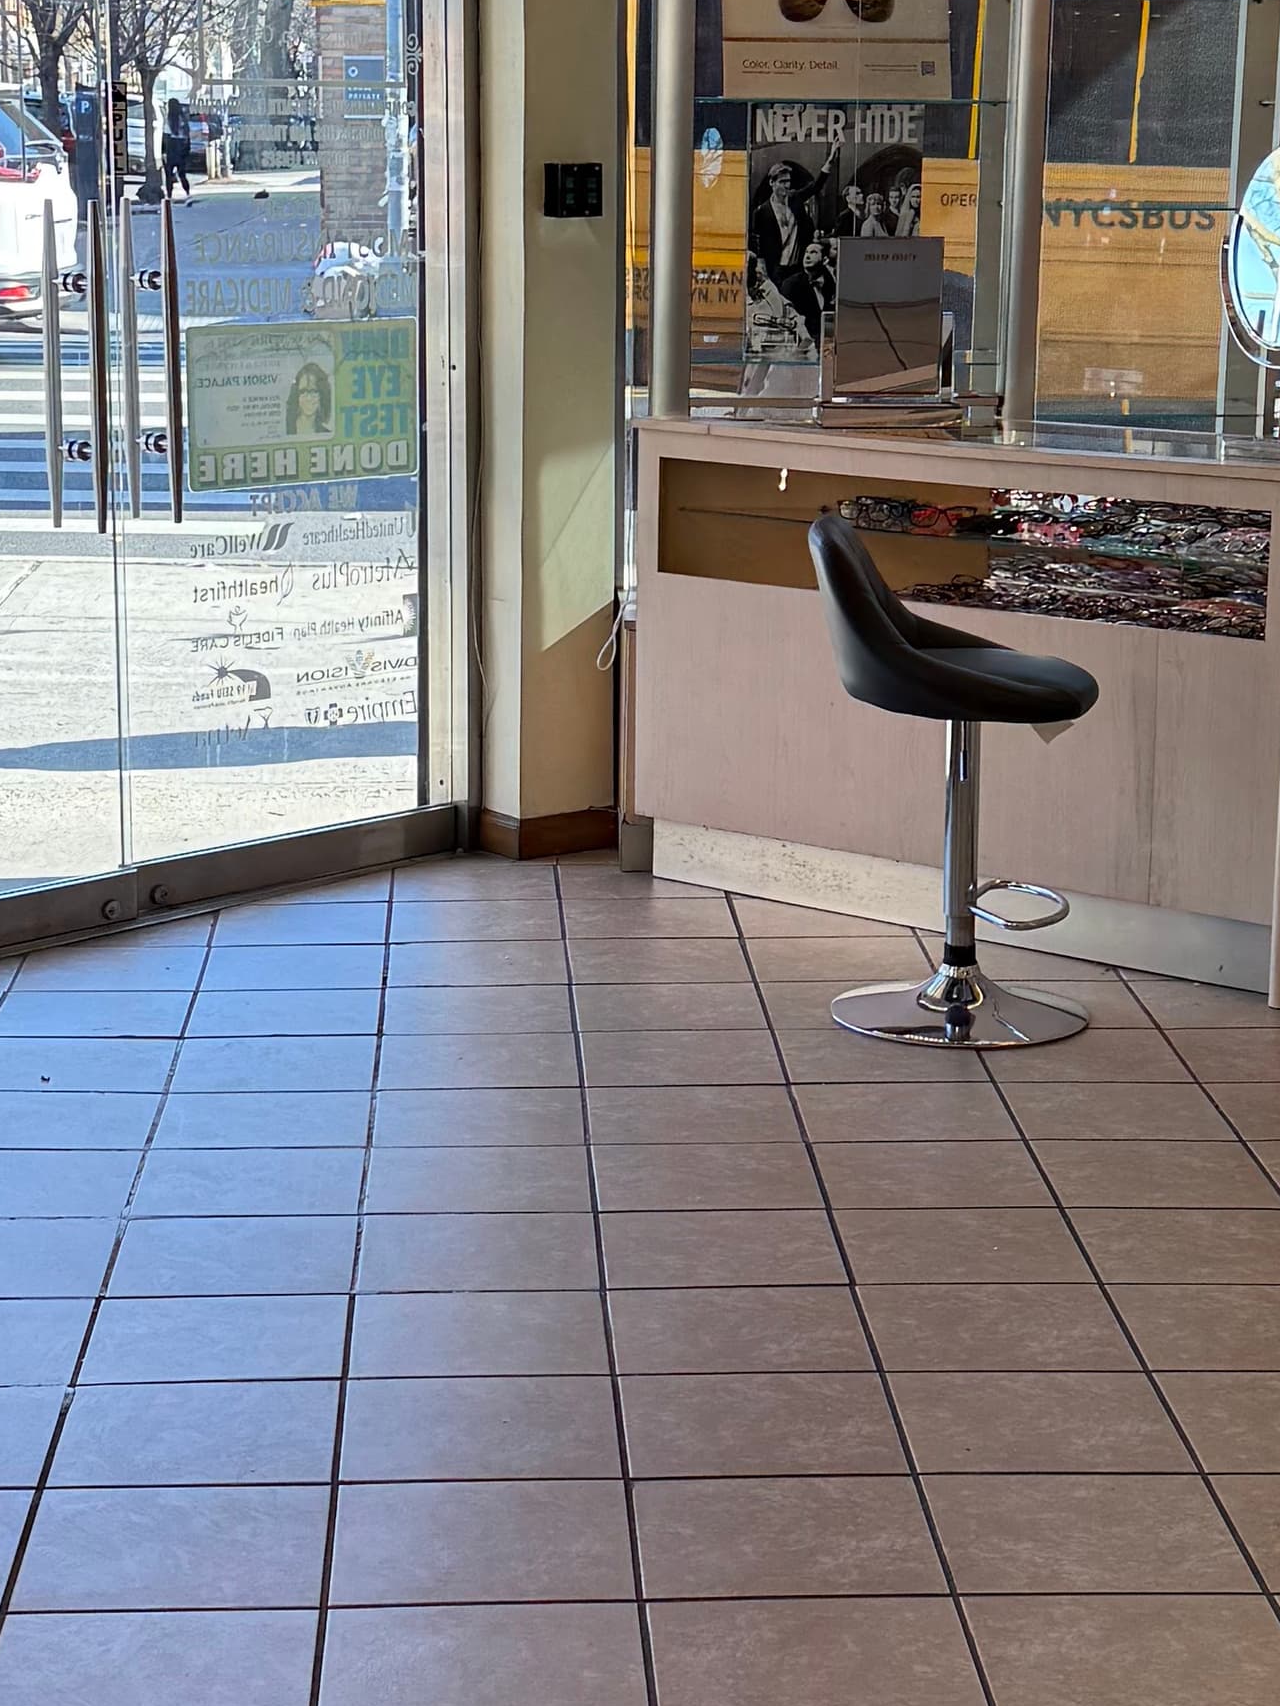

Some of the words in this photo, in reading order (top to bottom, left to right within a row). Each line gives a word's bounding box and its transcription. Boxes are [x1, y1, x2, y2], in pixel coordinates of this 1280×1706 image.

[742, 59, 769, 70] Color.
[773, 59, 806, 71] Clarity.
[809, 60, 839, 70] Detail.
[80, 100, 90, 113] P
[755, 108, 846, 143] NEVER
[855, 108, 919, 143] HIDE
